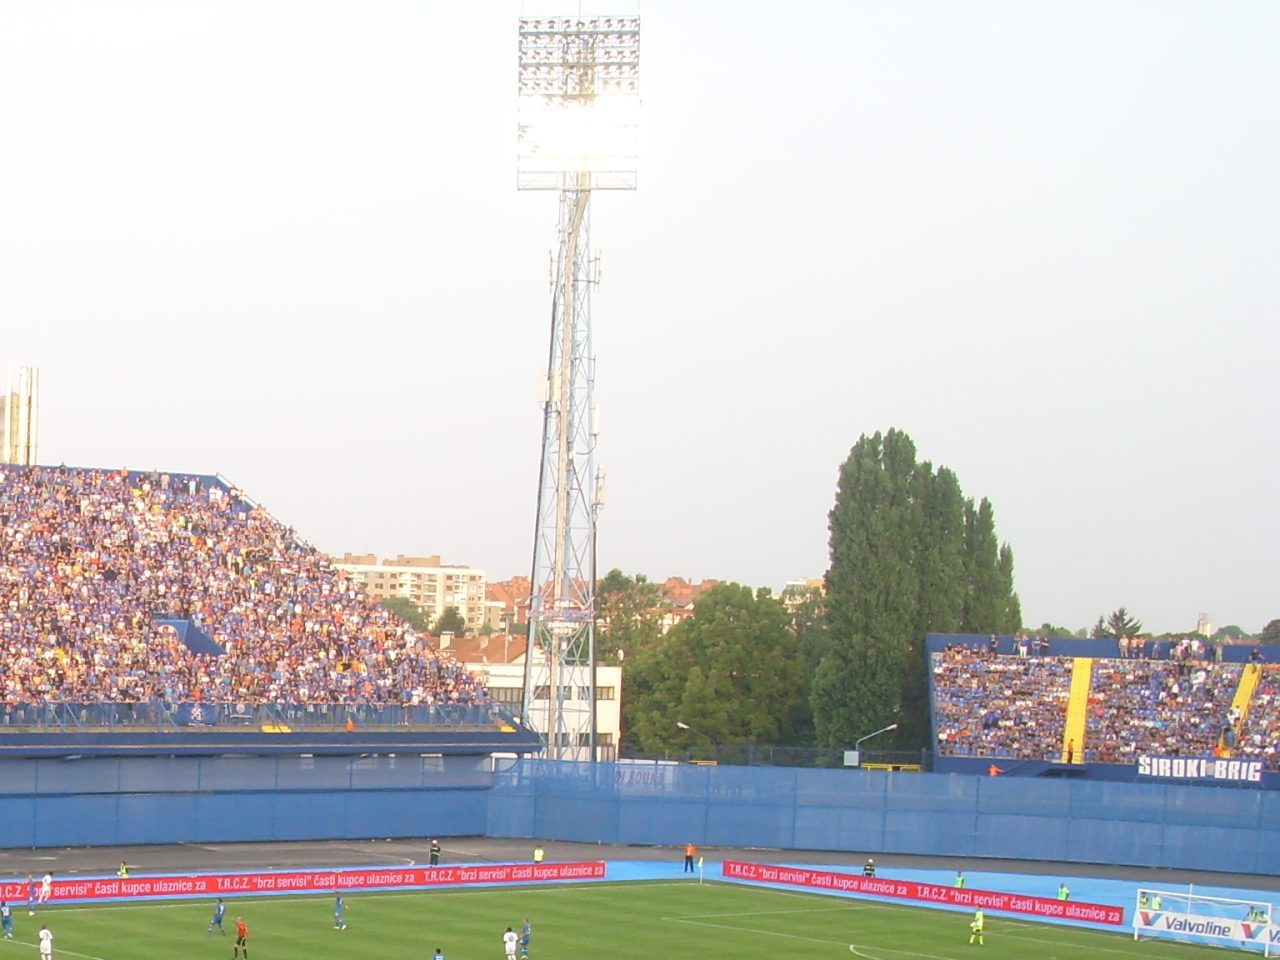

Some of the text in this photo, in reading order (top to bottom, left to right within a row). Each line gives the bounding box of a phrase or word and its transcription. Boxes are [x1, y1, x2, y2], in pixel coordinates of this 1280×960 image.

[1214, 760, 1261, 781] BRIG
[217, 877, 251, 891] T.R.C.Z.
[313, 874, 335, 887] časti
[337, 873, 364, 888] kupce
[367, 872, 402, 885] ulaznice
[404, 874, 414, 884] za
[424, 870, 454, 883] T.R.C.Z.
[511, 867, 532, 879] časti
[534, 866, 557, 880] kupce
[560, 865, 592, 877] ulaznice
[594, 867, 603, 876] za
[730, 863, 757, 878] T.R.C.Z.
[811, 873, 831, 887] časti
[833, 876, 858, 892] kupce
[860, 879, 894, 895] ulaznice
[896, 886, 907, 896] za
[95, 882, 119, 896] časti
[121, 881, 150, 897] kupce
[153, 879, 192, 894] ulaznice
[195, 881, 206, 892] za
[916, 886, 947, 901] T.R.C.Z.
[1010, 897, 1032, 912] časti
[1034, 900, 1063, 917] kupce
[1066, 904, 1105, 921] ulaznice
[1108, 912, 1120, 923] za
[1166, 916, 1231, 937] Valvoline
